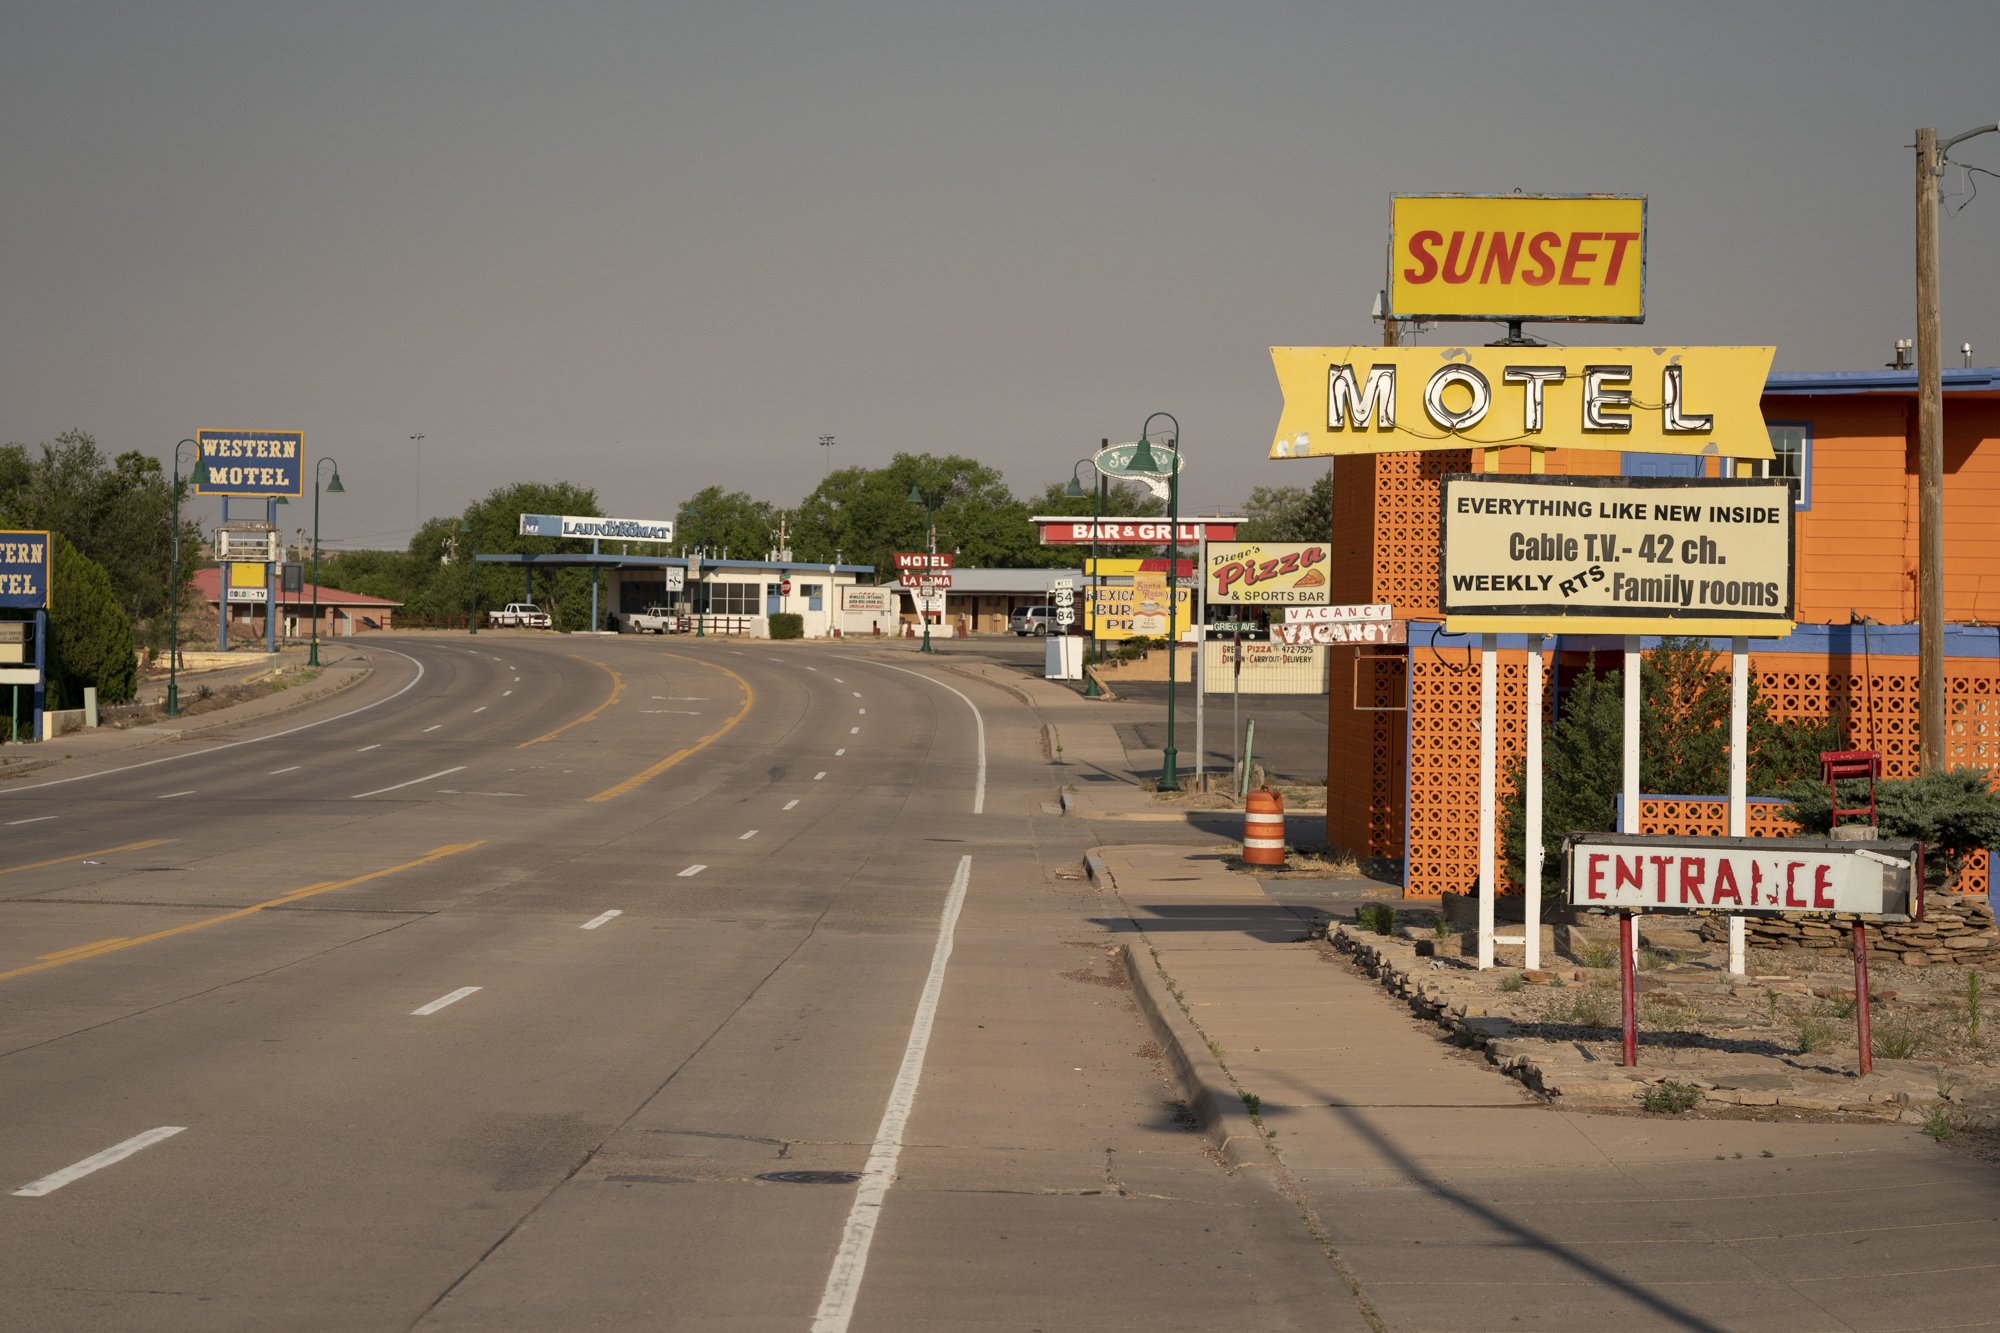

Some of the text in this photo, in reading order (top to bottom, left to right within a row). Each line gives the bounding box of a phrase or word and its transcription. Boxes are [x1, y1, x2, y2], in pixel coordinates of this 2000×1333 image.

[1403, 230, 1640, 286] SUNSET
[1327, 363, 1713, 435] MOTEL
[202, 439, 296, 458] WESTERN
[209, 466, 289, 485] MOTEL
[1457, 497, 1780, 523] EVERYTHING LIKE NEW INSIDE
[563, 521, 670, 539] LAUNDROMAT
[1073, 524, 1120, 539] BAR
[1123, 525, 1135, 536] &
[1212, 546, 1260, 566] Diego's
[1509, 531, 1578, 562] Cable
[1638, 533, 1674, 563] 42
[1681, 535, 1726, 565] ch.
[900, 556, 949, 567] MOTEL
[1212, 546, 1327, 596] Pizza
[903, 576, 917, 586] LA
[1136, 581, 1161, 592] Santa
[1057, 592, 1073, 602] 54
[1231, 591, 1325, 601] & SPORTS BAR
[1452, 574, 1554, 591] WEEKLY
[1700, 579, 1779, 606] rooms
[1057, 611, 1074, 621] 84
[1290, 606, 1386, 620] VACANCY
[1214, 622, 1238, 631] GRIEG
[1247, 645, 1272, 653] PIZZA
